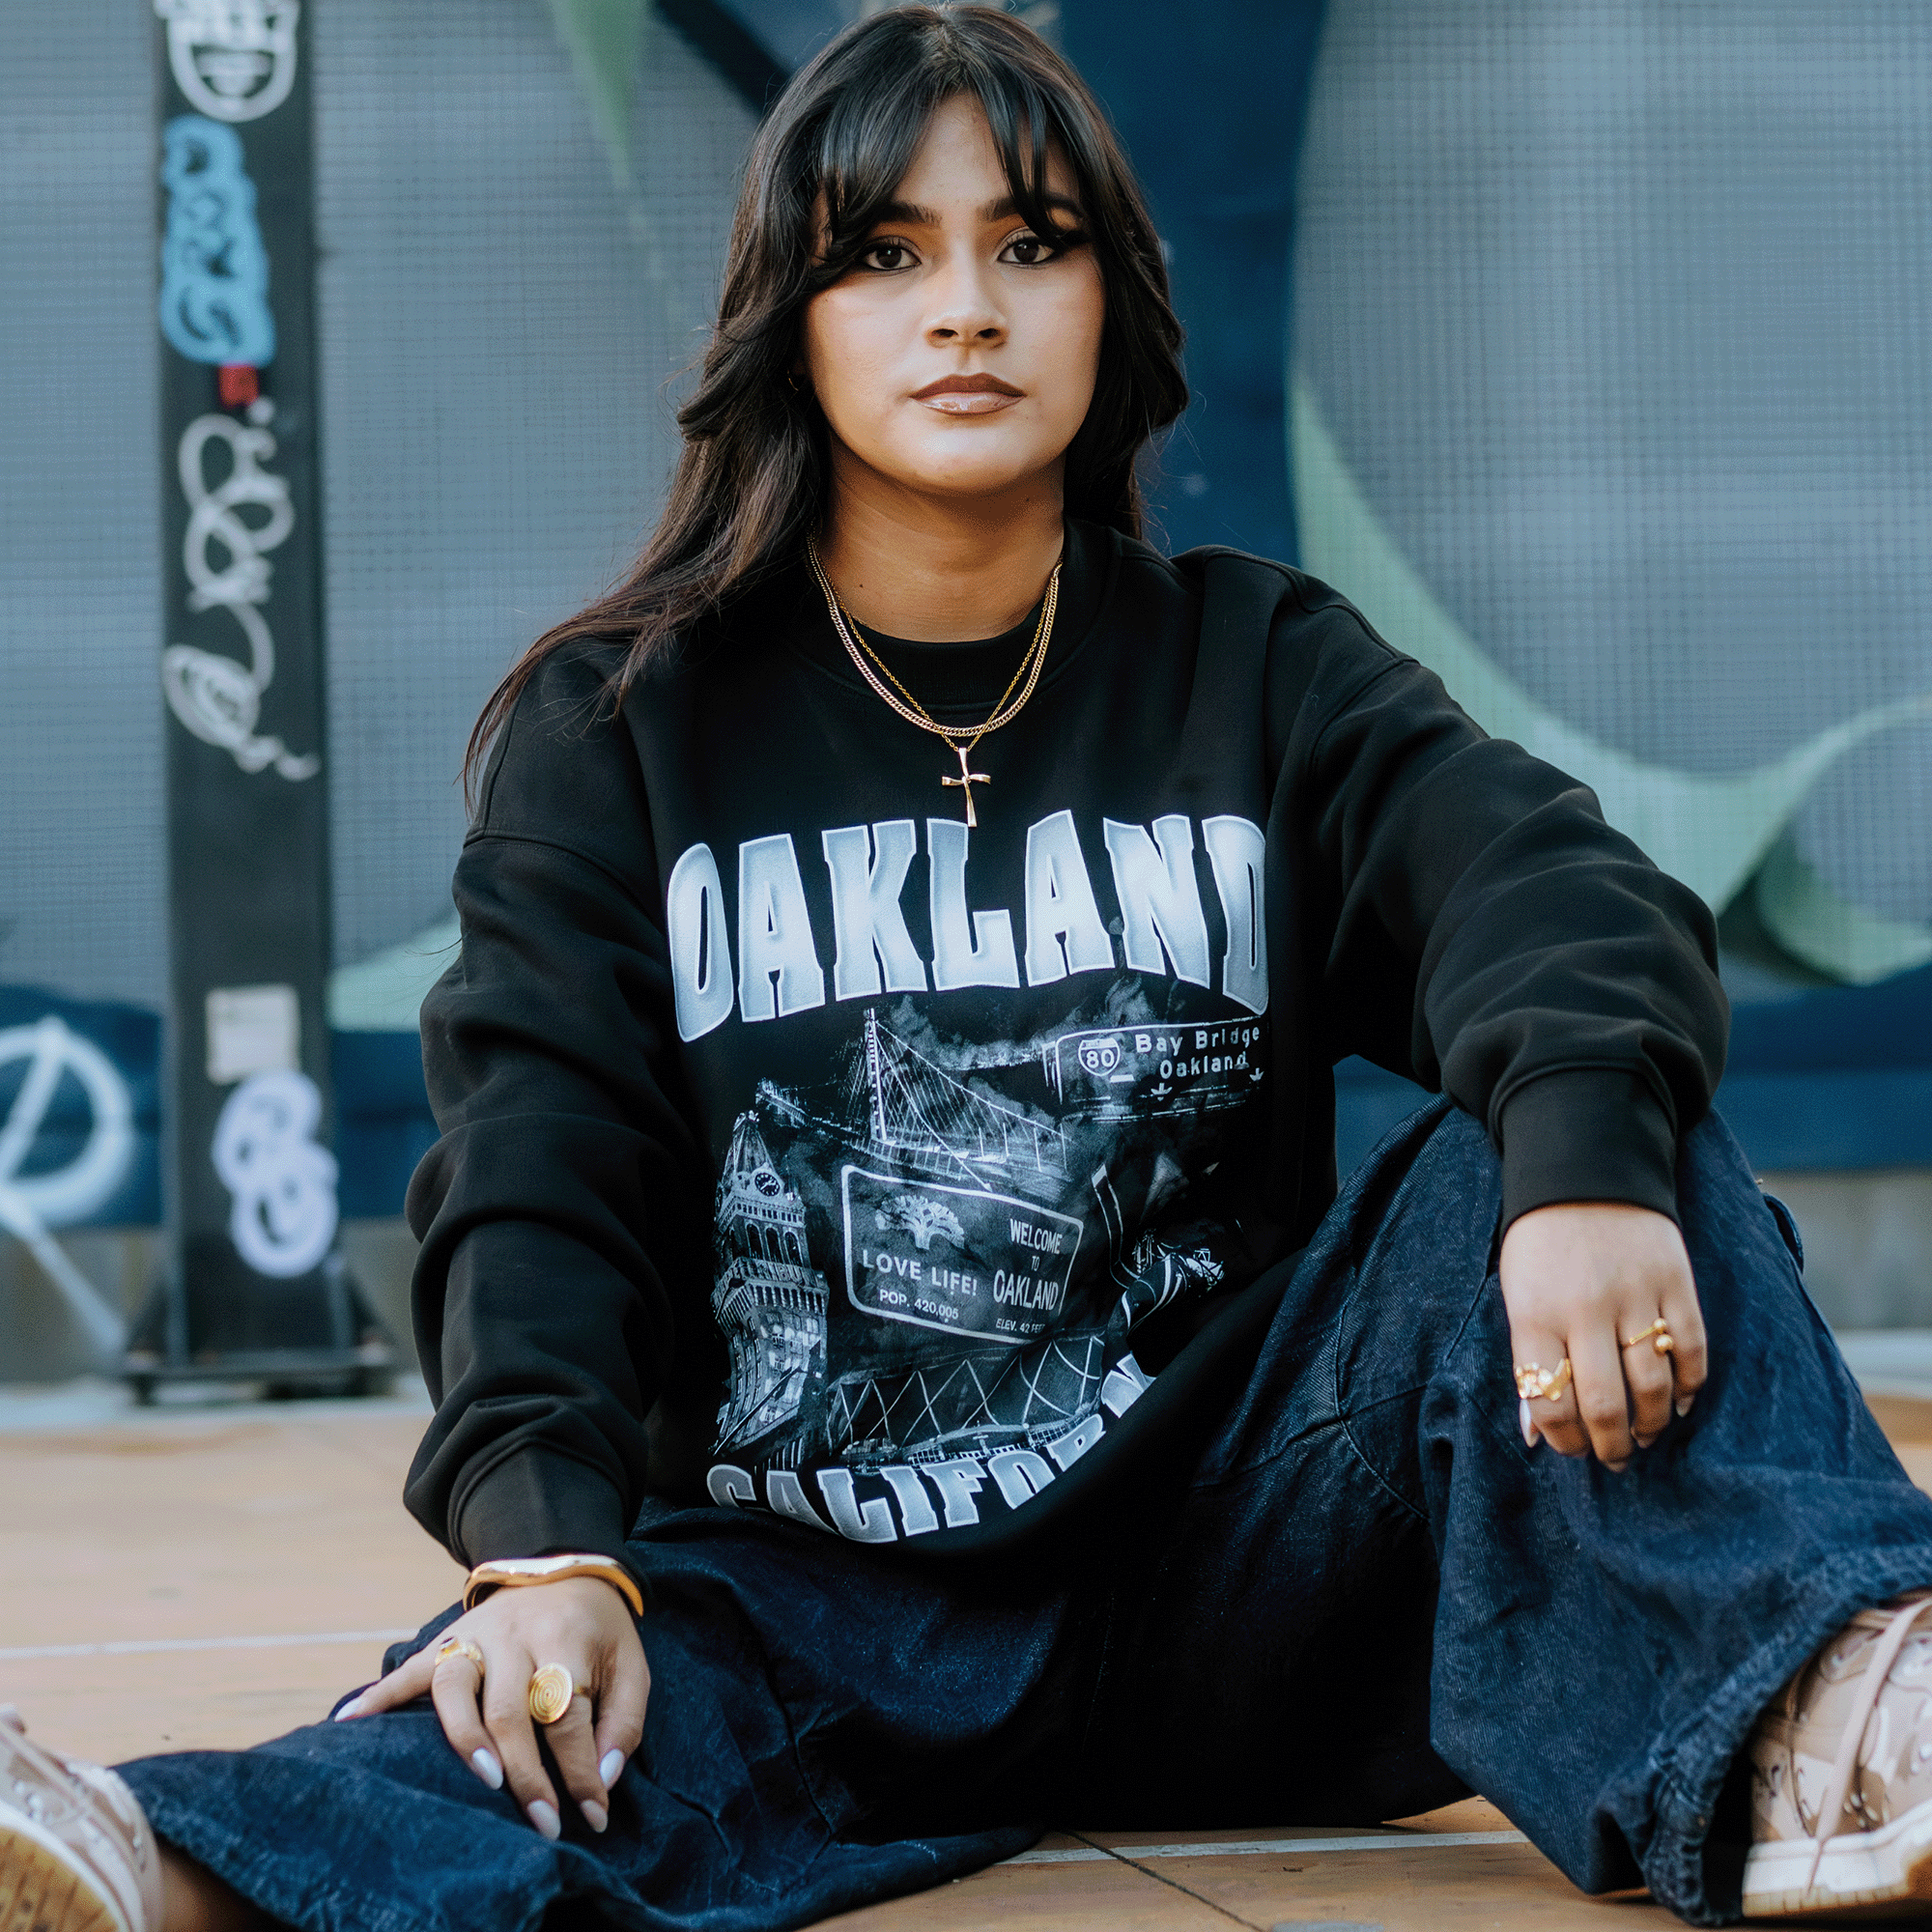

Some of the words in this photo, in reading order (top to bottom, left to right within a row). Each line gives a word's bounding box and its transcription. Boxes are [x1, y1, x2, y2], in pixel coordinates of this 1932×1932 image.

[668, 810, 1268, 1043] OAKLAND
[1134, 1034, 1183, 1057] Bay
[1195, 1027, 1261, 1049] Bridge
[1086, 1048, 1115, 1069] 80
[1159, 1050, 1247, 1080] Oakland
[1009, 1218, 1064, 1255] WELCOME
[863, 1249, 922, 1281] LOVE
[931, 1266, 978, 1296] LIFE!
[1031, 1256, 1041, 1272] TO
[879, 1289, 910, 1308] POP.
[914, 1297, 959, 1321] 420,005
[993, 1268, 1060, 1312] OAKLAND
[995, 1318, 1017, 1332] ELEV.
[1019, 1322, 1031, 1334] 42
